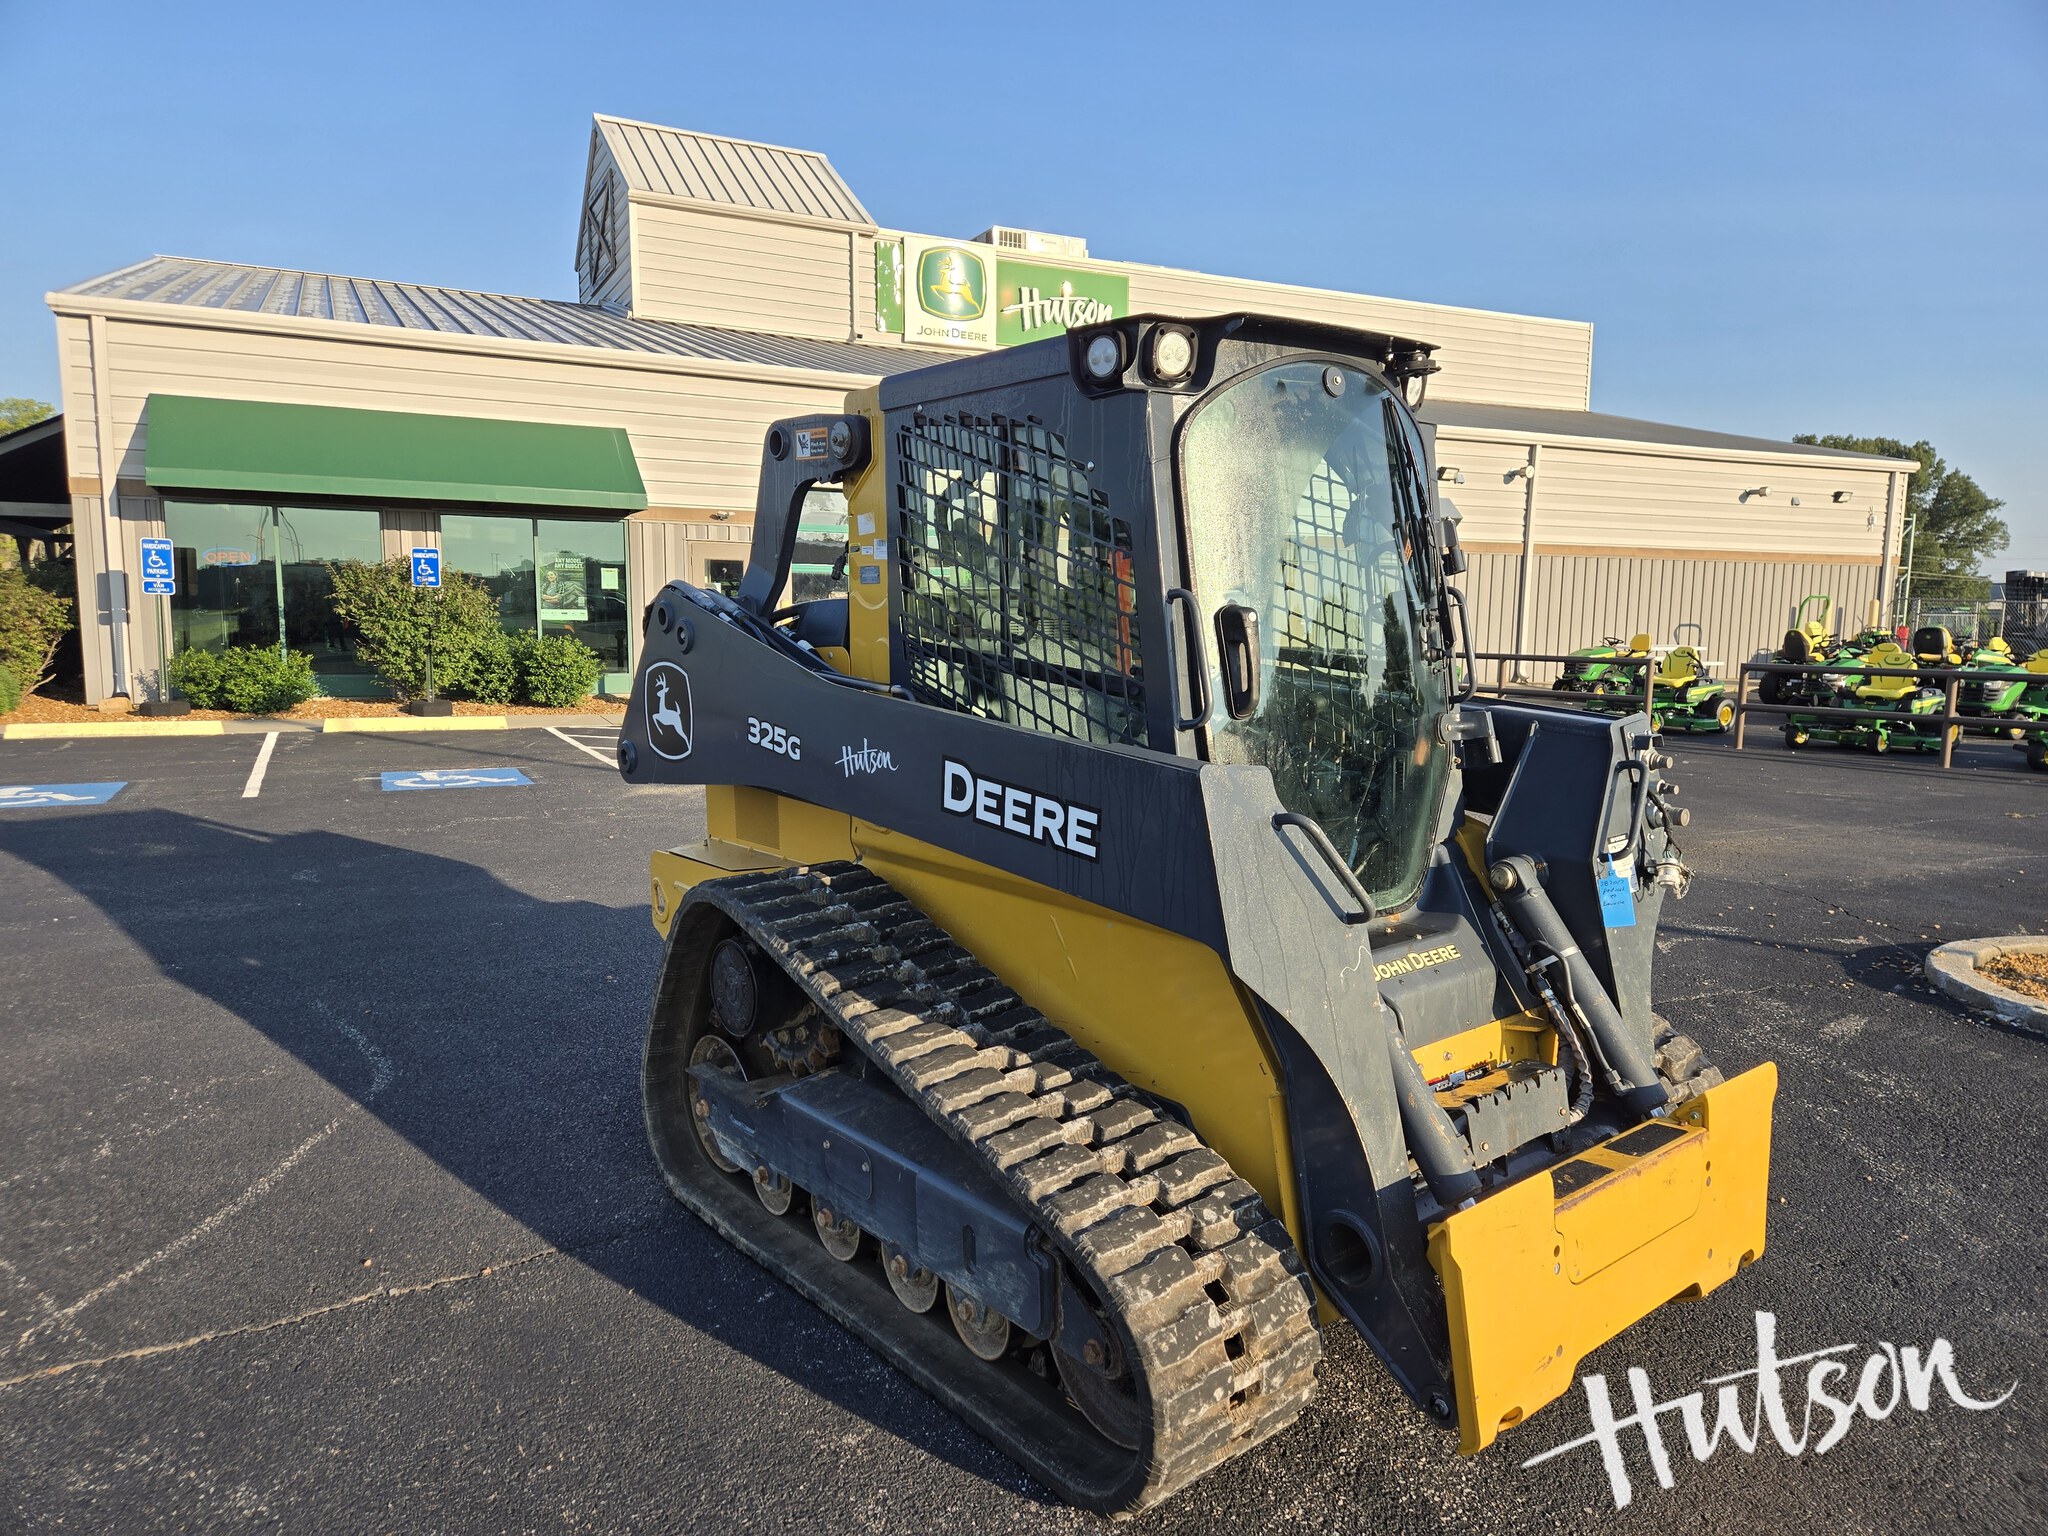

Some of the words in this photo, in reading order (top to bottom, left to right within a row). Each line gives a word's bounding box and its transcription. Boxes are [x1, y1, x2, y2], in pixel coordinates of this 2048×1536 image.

[1000, 280, 1113, 332] Hutson
[916, 325, 949, 338] JOHN
[951, 327, 988, 342] DEERE
[206, 552, 251, 563] OPEN
[747, 717, 801, 761] 325G
[835, 738, 899, 778] Hutson
[943, 760, 1099, 858] DEERE
[1373, 958, 1413, 982] JOHN
[1407, 944, 1461, 970] DEERE
